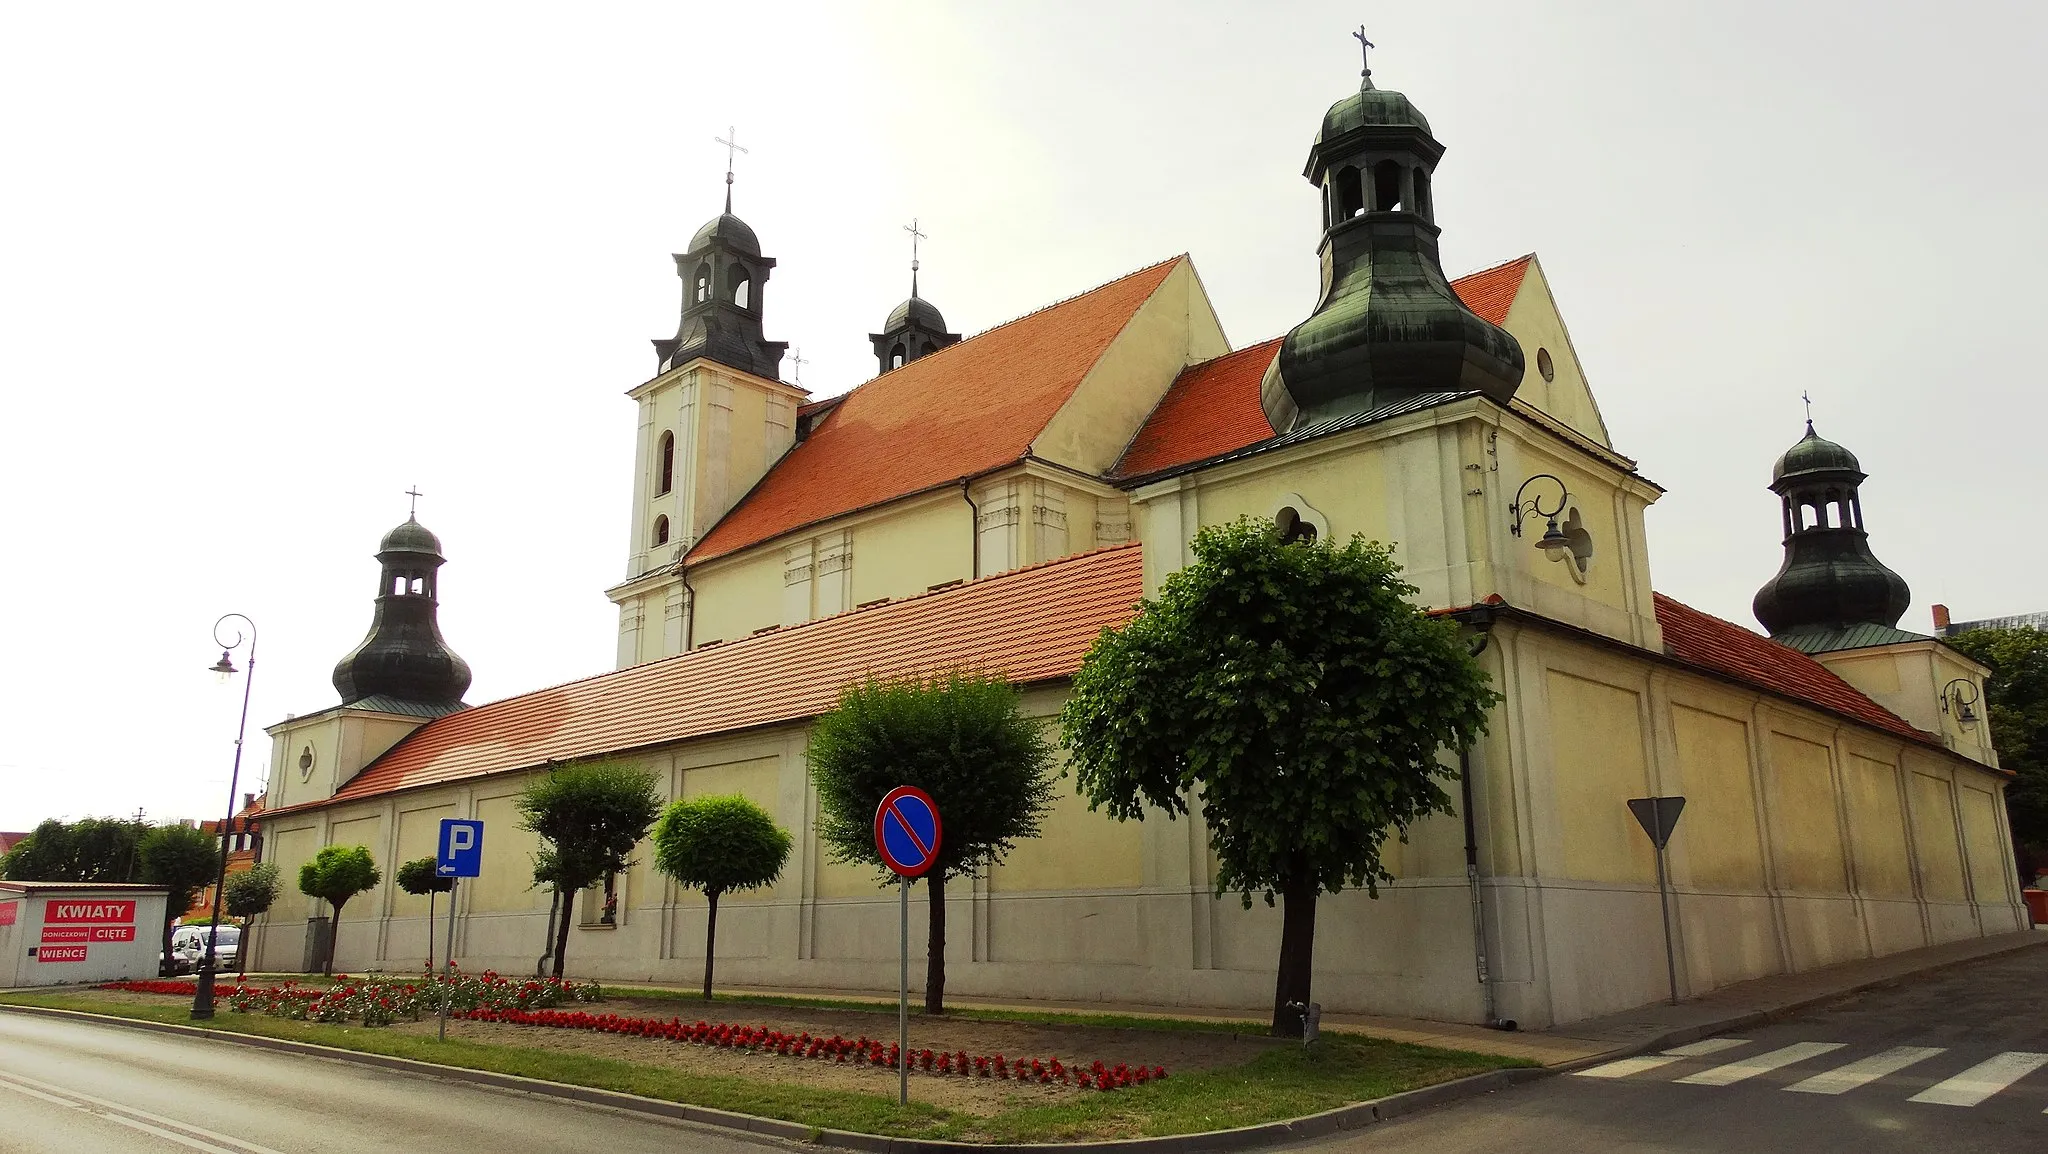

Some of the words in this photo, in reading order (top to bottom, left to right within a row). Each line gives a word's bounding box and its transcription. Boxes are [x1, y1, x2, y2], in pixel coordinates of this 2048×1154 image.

[448, 824, 475, 860] P
[56, 905, 126, 918] KWIATY
[96, 929, 127, 939] CIĘTE
[41, 947, 86, 958] WIEŃCE
